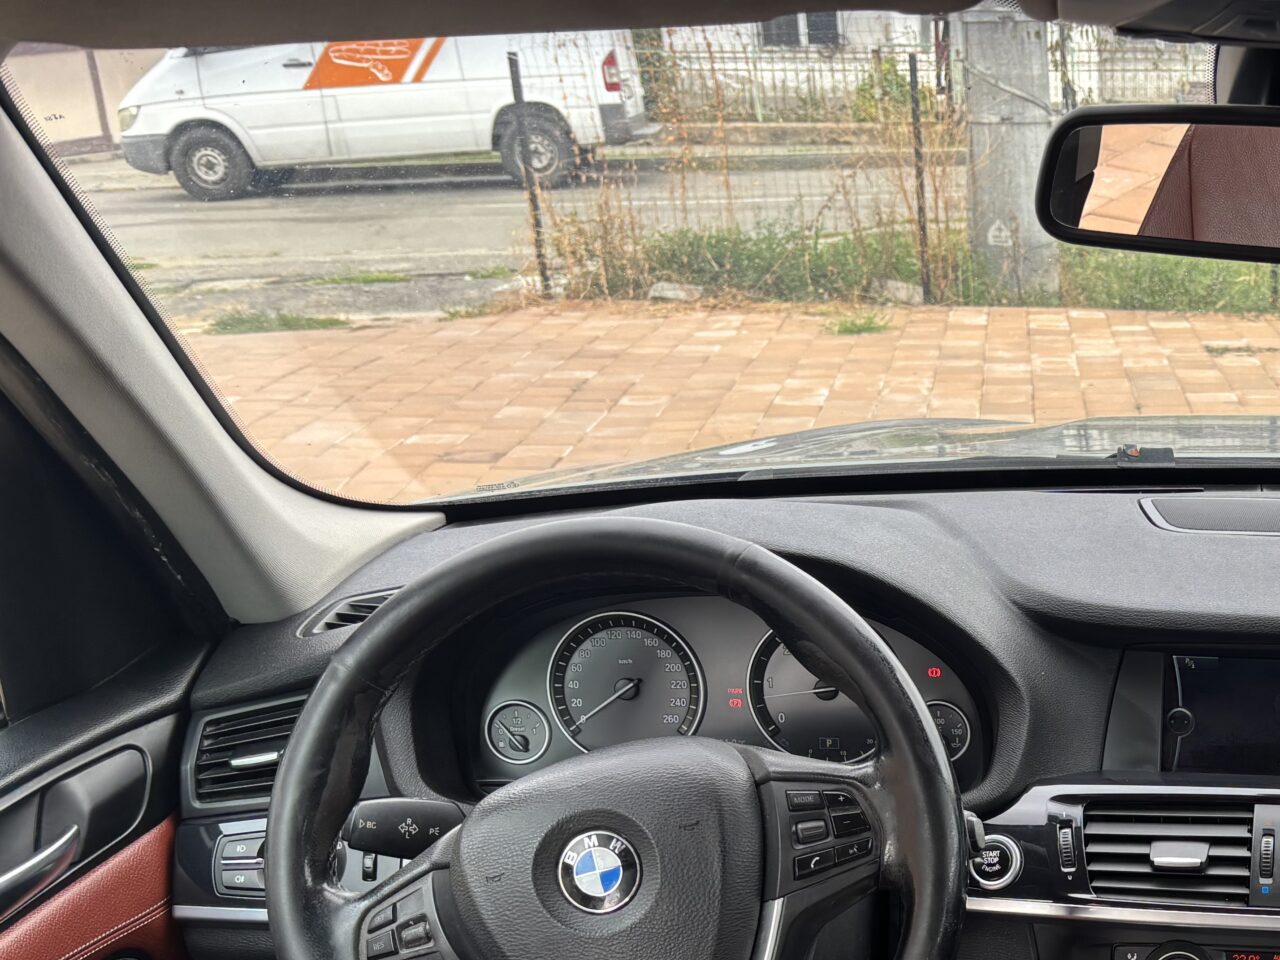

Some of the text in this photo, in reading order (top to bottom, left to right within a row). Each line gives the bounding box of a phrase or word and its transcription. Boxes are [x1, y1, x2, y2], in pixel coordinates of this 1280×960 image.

[608, 631, 622, 639] 120
[626, 631, 642, 639] 140
[592, 638, 606, 646] 100
[644, 638, 658, 646] 160
[580, 650, 591, 658] 80
[657, 650, 672, 658] 180
[571, 664, 582, 672] 60
[665, 664, 682, 672] 200
[568, 681, 579, 689] 40
[671, 681, 687, 689] 220
[767, 677, 774, 688] 1
[571, 698, 582, 707] 20
[670, 699, 687, 707] 240
[664, 715, 680, 724] 260
[778, 712, 786, 723] 0
[826, 739, 832, 748] P
[564, 834, 626, 866] BMW
[982, 850, 1000, 858] START
